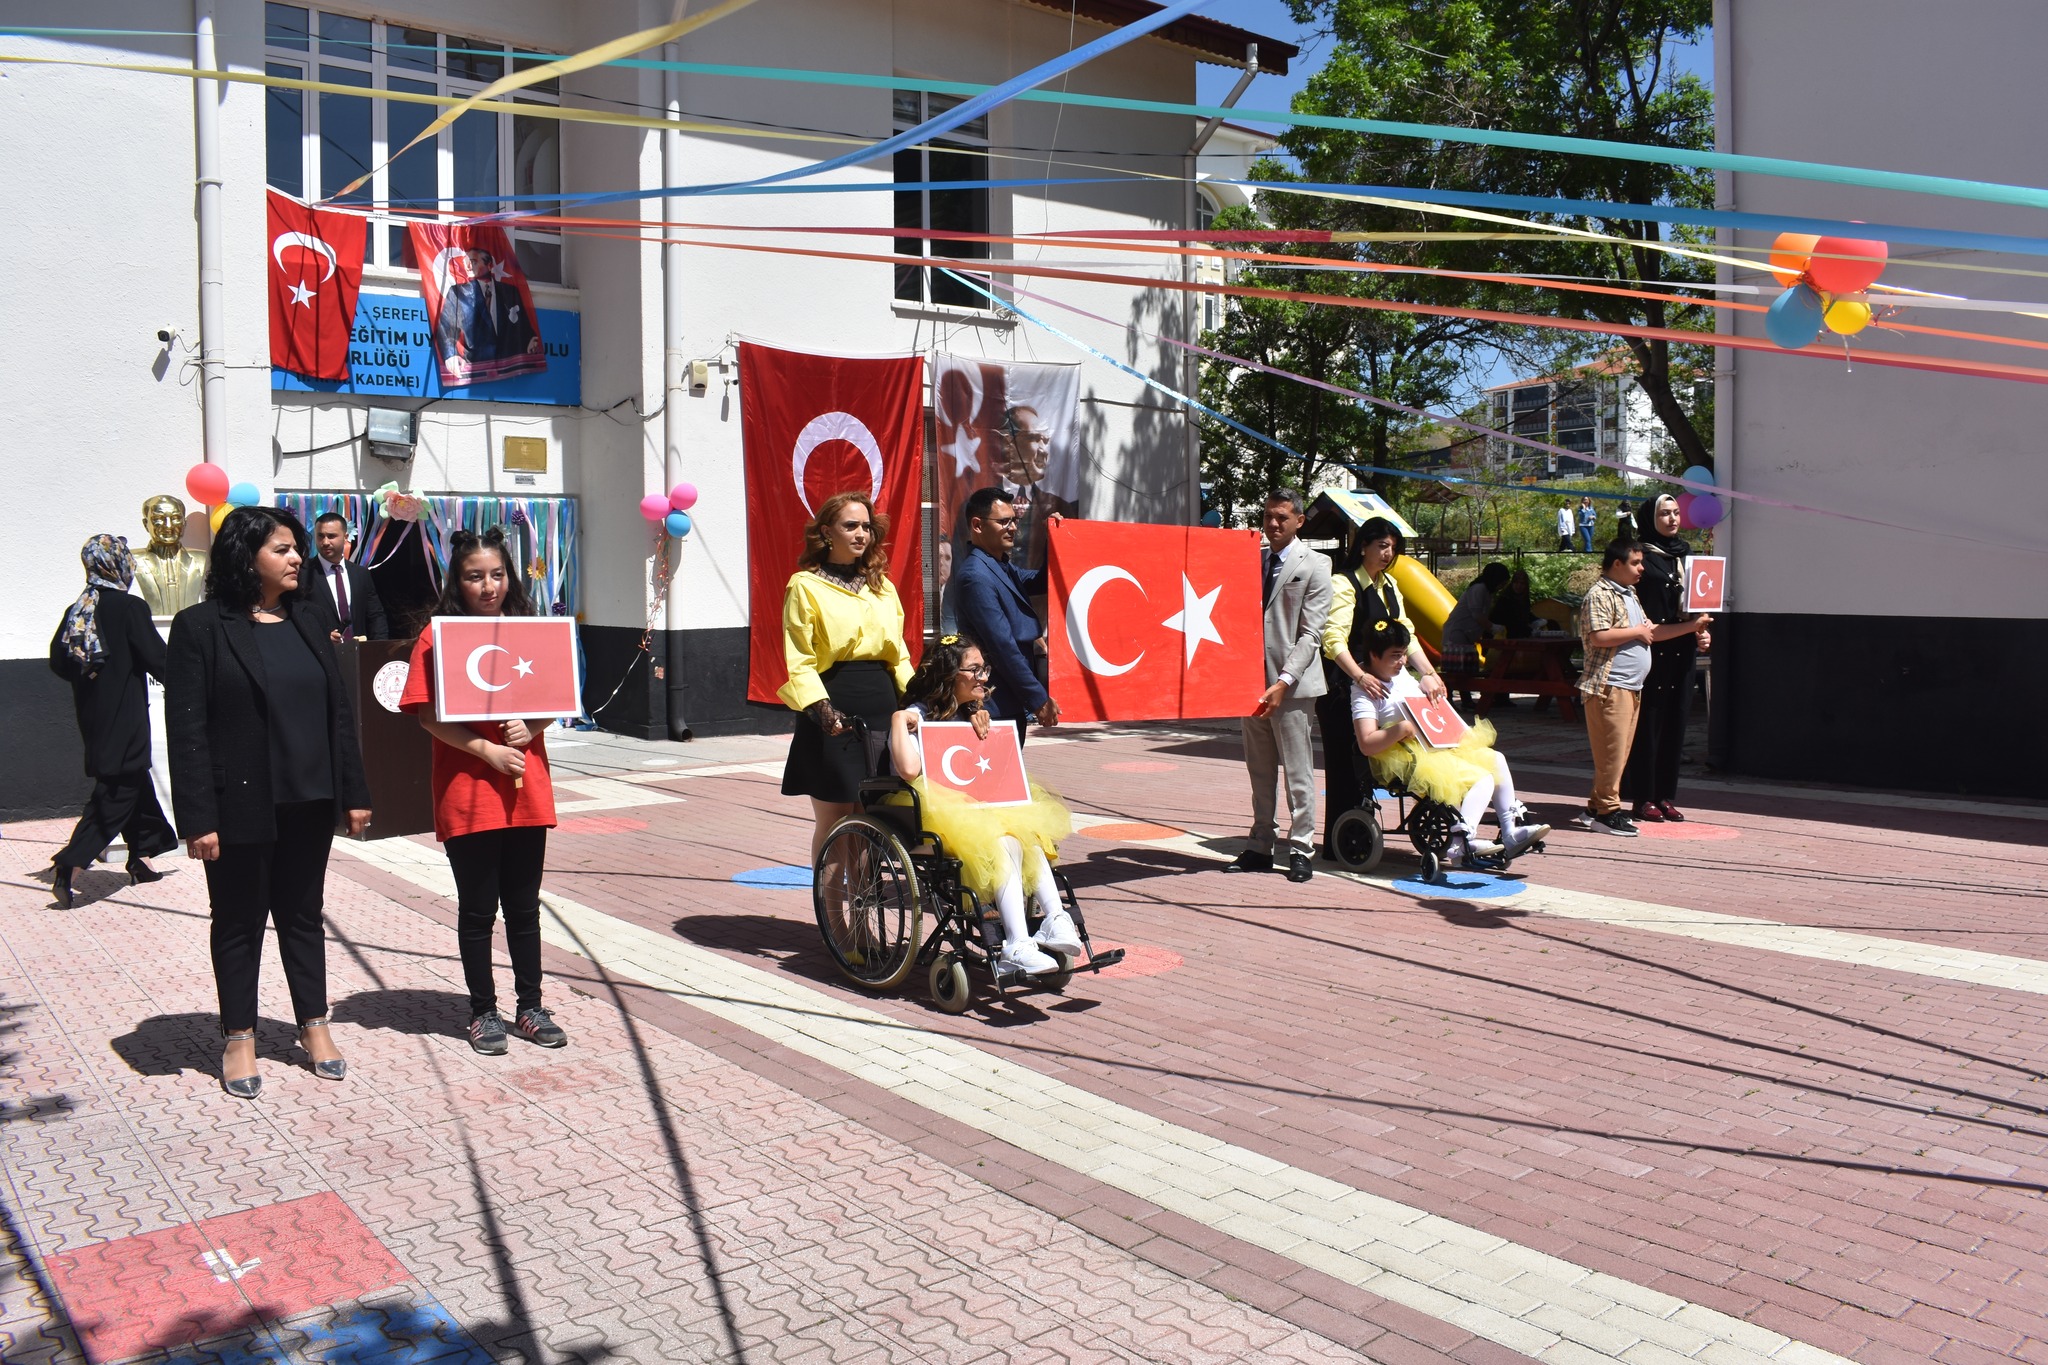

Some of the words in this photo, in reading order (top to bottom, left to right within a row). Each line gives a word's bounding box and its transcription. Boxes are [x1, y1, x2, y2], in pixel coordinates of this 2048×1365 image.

[349, 324, 408, 346] EĞİTİM
[346, 348, 410, 368] RLÜĞÜ
[356, 373, 420, 389] KADEME)
